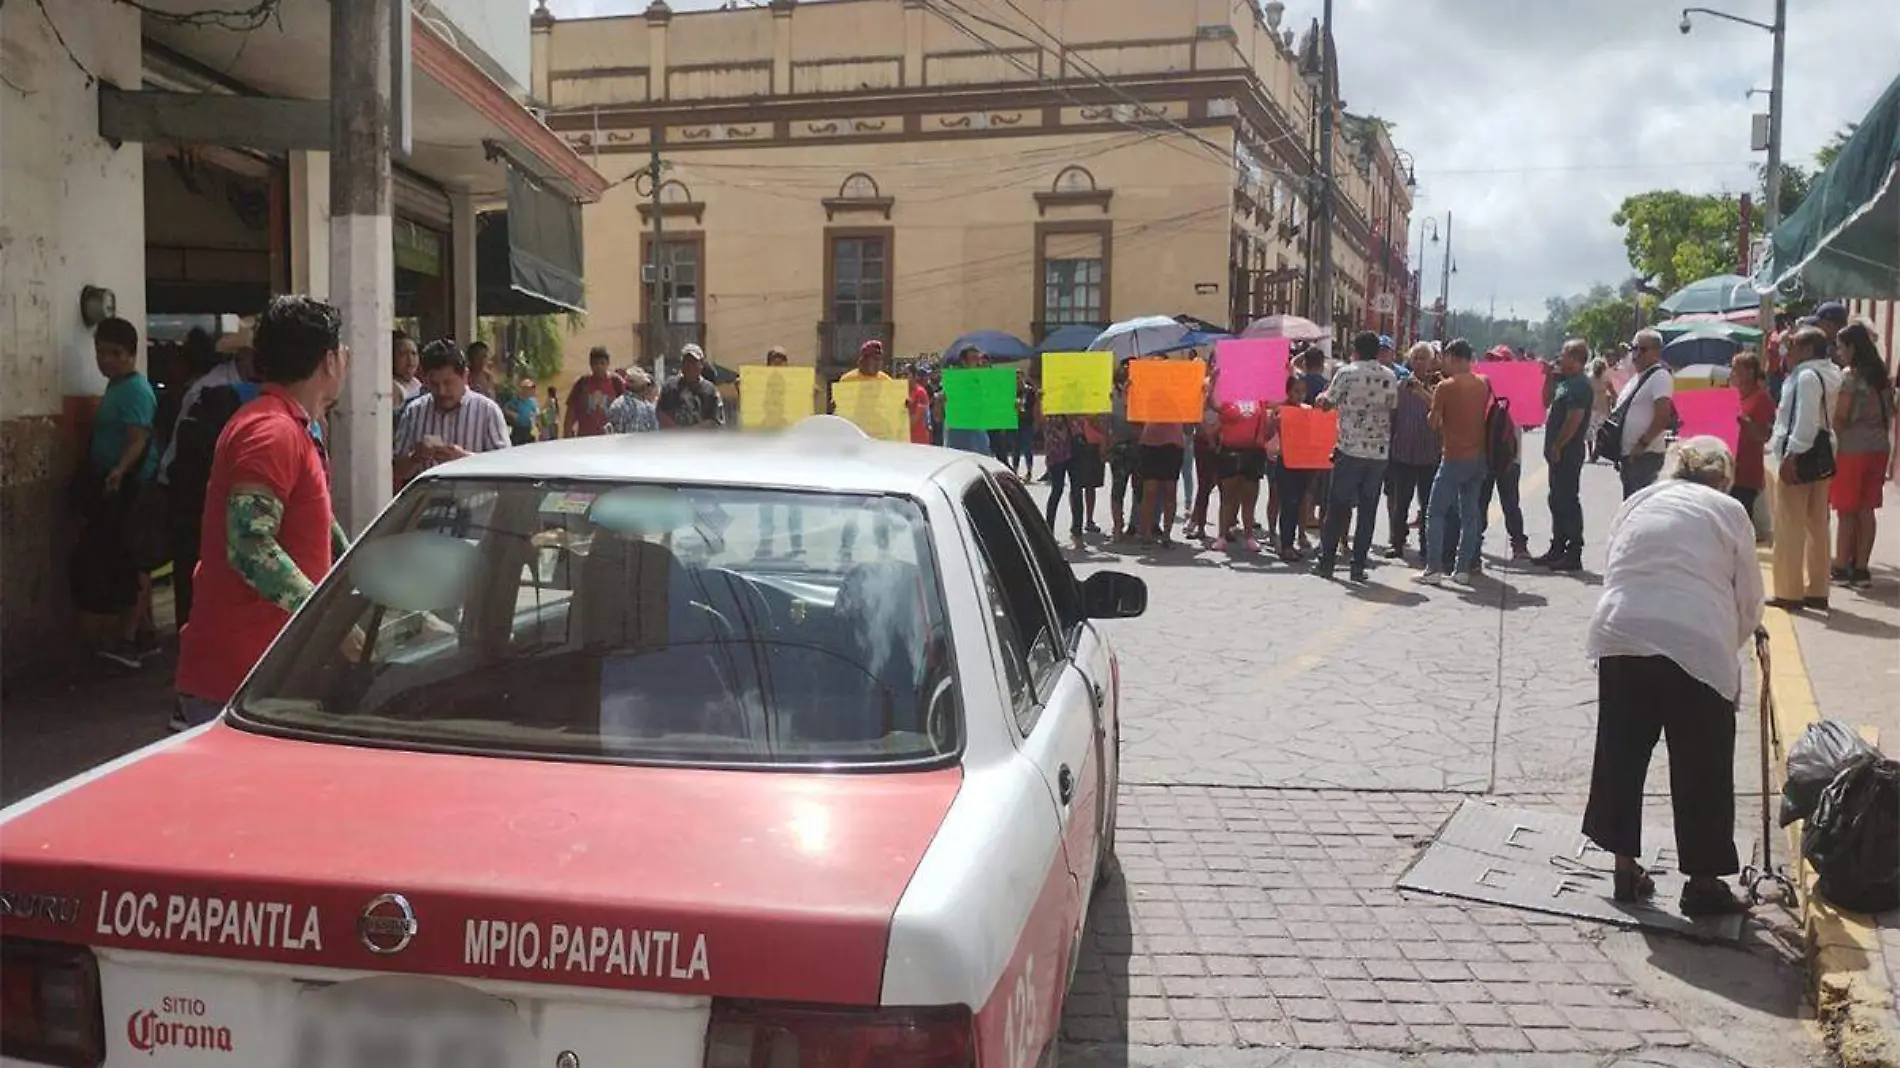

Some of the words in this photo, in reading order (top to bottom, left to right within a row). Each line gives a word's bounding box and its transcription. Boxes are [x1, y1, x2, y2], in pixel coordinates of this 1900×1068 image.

[96, 890, 322, 951] LOC.PAPANTLA
[465, 919, 710, 981] MPIO.PAPANTLA
[127, 1009, 233, 1056] Corona
[162, 996, 206, 1016] SITIO
